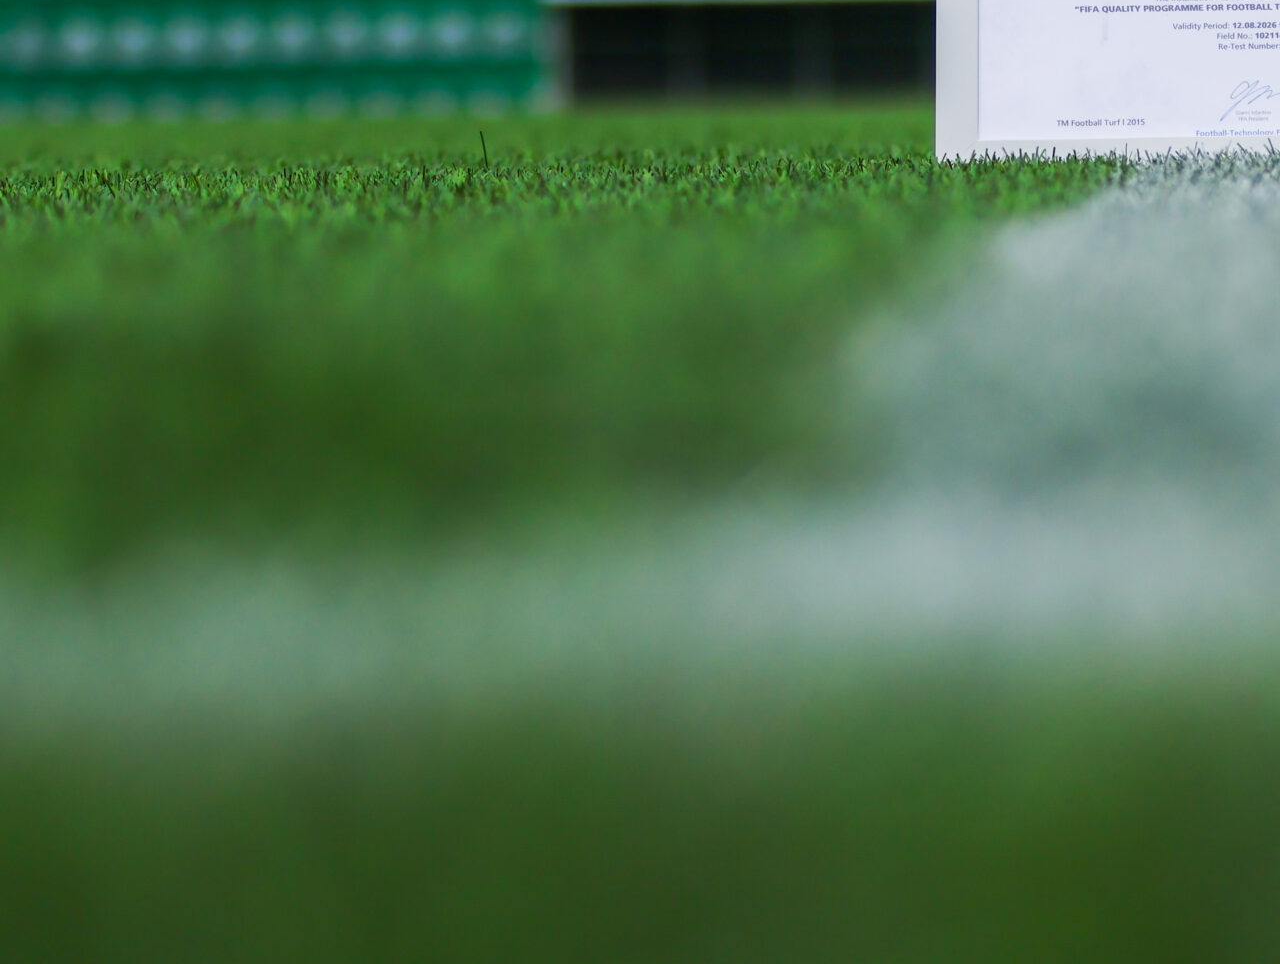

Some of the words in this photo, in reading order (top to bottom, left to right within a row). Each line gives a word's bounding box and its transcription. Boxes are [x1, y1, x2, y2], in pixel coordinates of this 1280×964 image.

[1101, 4, 1141, 14] QUALITY
[1143, 4, 1204, 13] PROGRAMME
[1205, 3, 1224, 12] FOR
[1226, 3, 1273, 12] FOOTBALL
[1172, 21, 1202, 31] Validity
[1232, 21, 1278, 30] 12.08.2026
[1216, 32, 1235, 40] Field
[1217, 43, 1247, 51] Re-Test
[1057, 119, 1069, 127] TM
[1071, 118, 1102, 127] Football
[1105, 118, 1120, 126] Turf
[1127, 118, 1146, 126] 2015
